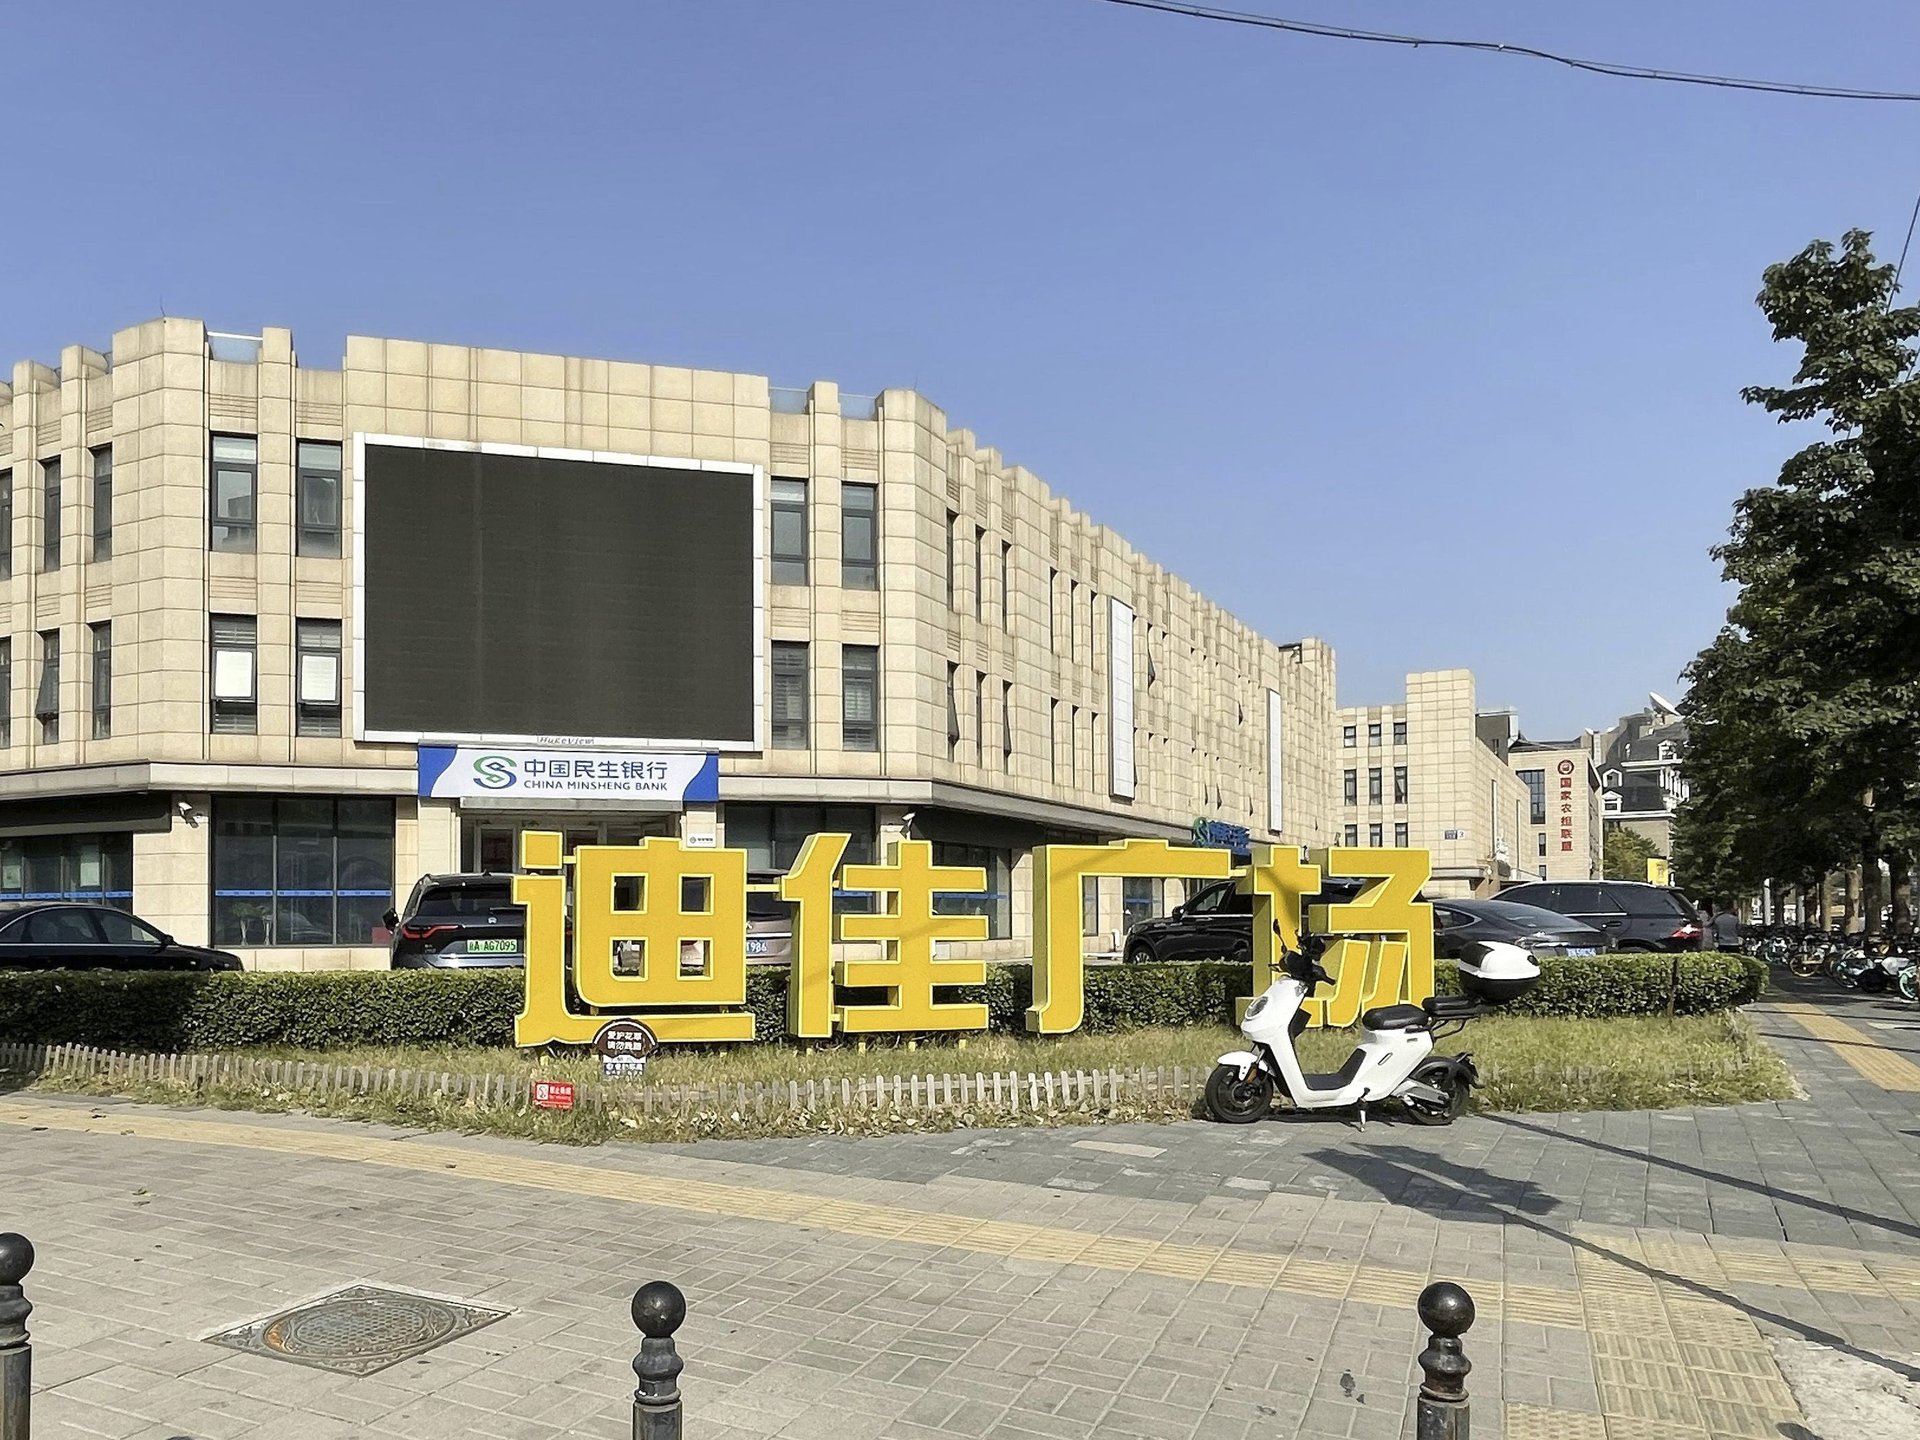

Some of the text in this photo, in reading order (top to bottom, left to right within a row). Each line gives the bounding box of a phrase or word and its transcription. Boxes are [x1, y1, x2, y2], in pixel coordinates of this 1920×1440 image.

[524, 759, 668, 780] 中国民生银行
[523, 780, 668, 792] CHINA MINSHENG BANK
[1560, 777, 1573, 852] 国家农担联盟
[512, 830, 1435, 1047] 迪佳广场
[607, 1030, 642, 1041] 爱护花草
